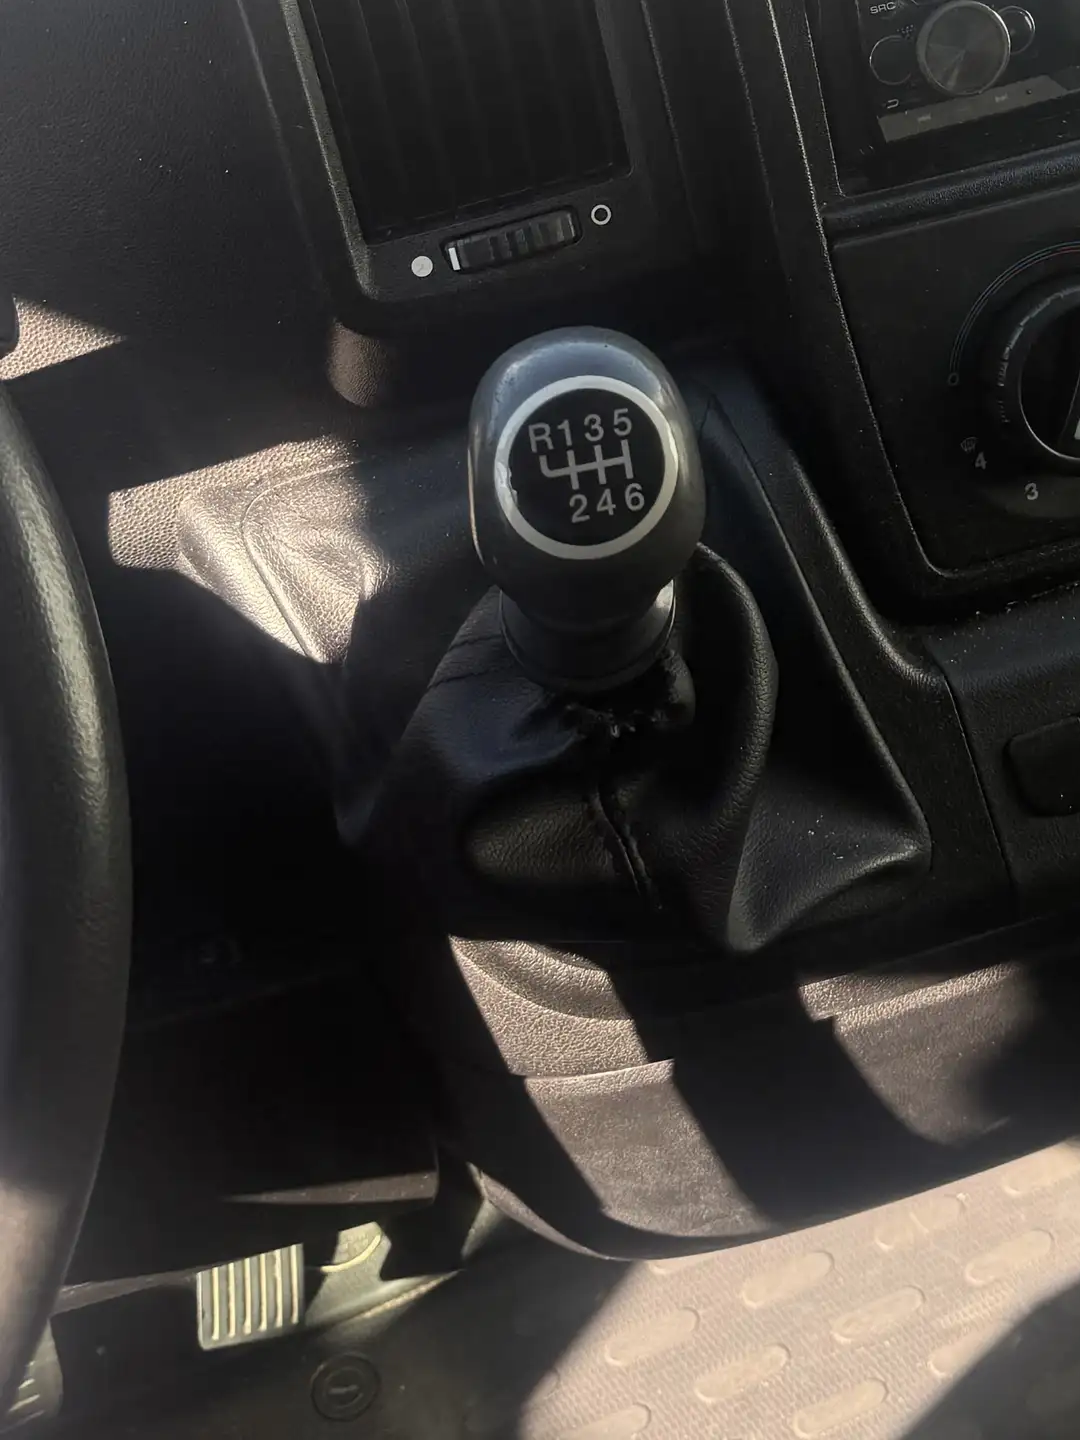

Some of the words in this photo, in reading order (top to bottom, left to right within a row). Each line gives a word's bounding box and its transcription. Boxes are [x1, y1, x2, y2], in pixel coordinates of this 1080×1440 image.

[870, 1, 897, 15] SRC
[528, 422, 554, 453] R
[557, 419, 573, 446] 1
[583, 414, 605, 442] 3
[613, 408, 633, 437] 5
[974, 452, 987, 470] 4
[1024, 482, 1039, 500] 3
[569, 494, 590, 524] 2
[596, 488, 616, 515] 4
[624, 483, 645, 511] 6
